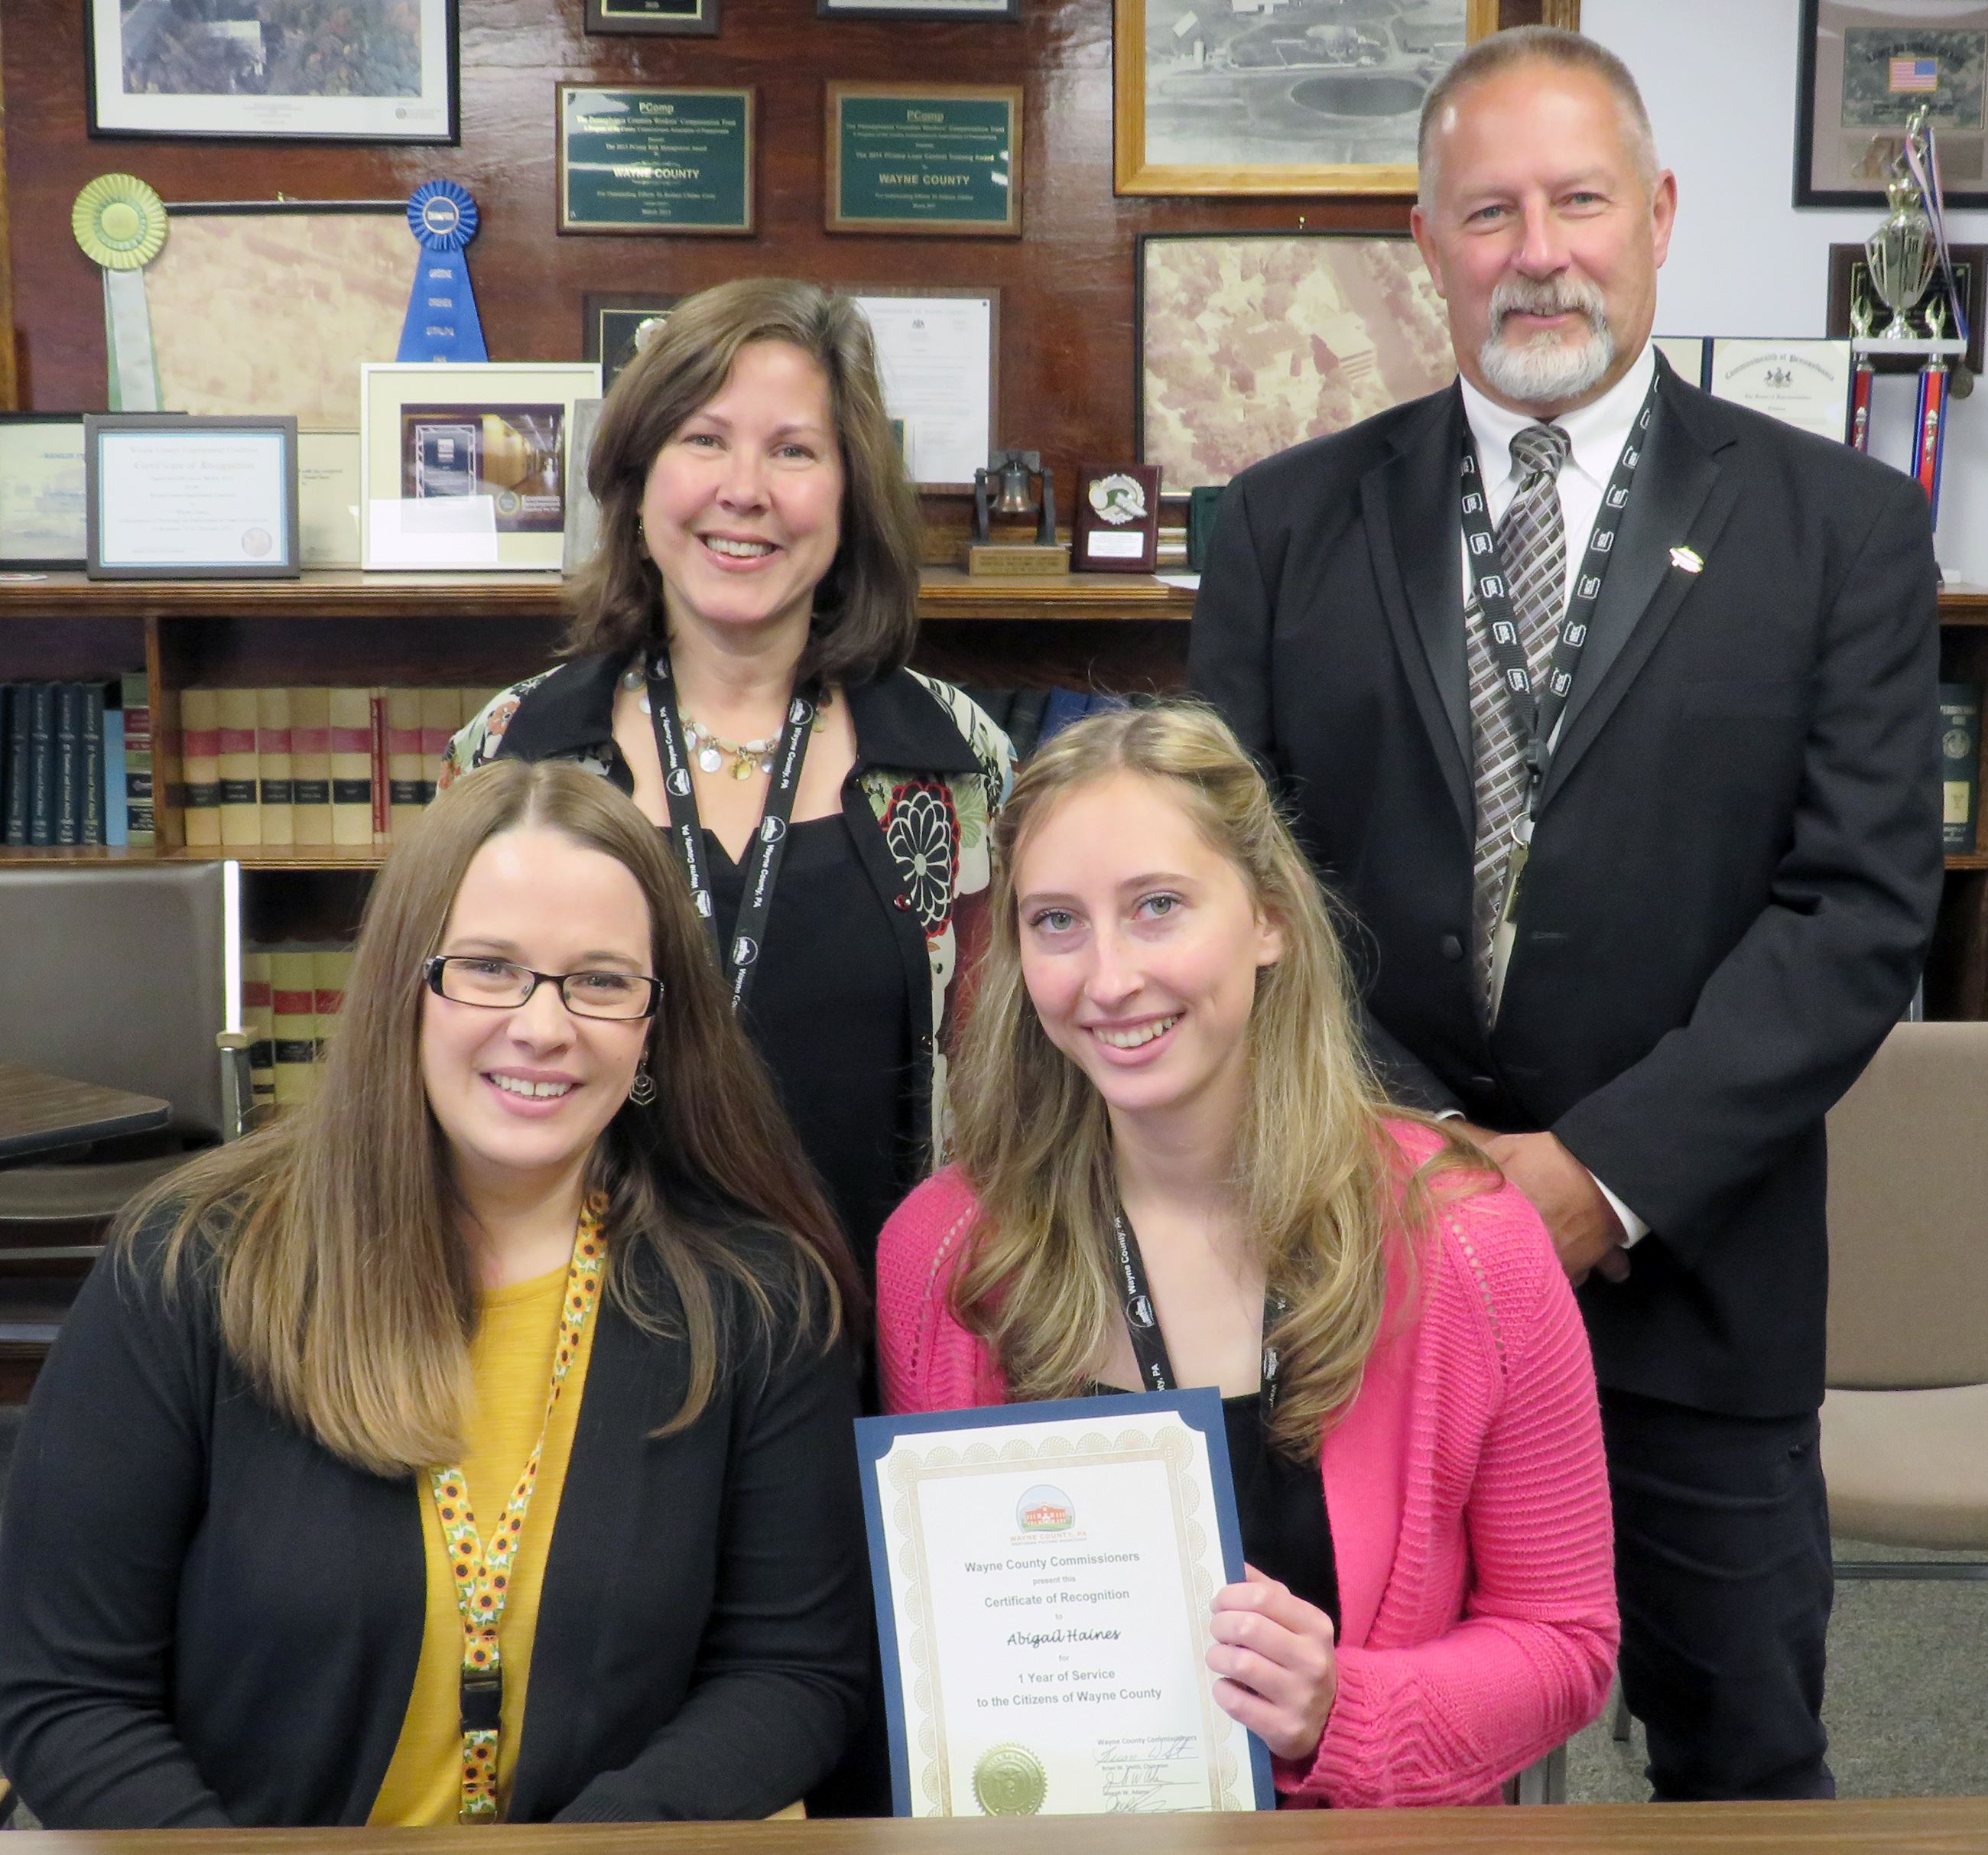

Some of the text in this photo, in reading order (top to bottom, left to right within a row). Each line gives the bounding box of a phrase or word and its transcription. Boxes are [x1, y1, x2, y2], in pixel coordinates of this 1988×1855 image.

[638, 102, 674, 114] PComp
[906, 109, 945, 122] PComp
[612, 166, 700, 179] WAYNE COUNTY
[879, 174, 970, 185] WAYNE COUNTY
[788, 727, 802, 752] Wayne
[681, 824, 690, 836] PA
[762, 844, 775, 869] Wayne
[690, 864, 699, 889] Wayne
[752, 897, 763, 908] PA
[735, 968, 746, 994] Wayne
[1114, 1217, 1122, 1228] PA
[1124, 1264, 1137, 1295] Wayne
[1151, 1363, 1159, 1377] PA
[964, 1552, 1140, 1574] Wayne County Commissioners
[1032, 1577, 1061, 1586] present
[984, 1589, 1130, 1608] Certificate of Recognition
[1007, 1628, 1121, 1649] Abigail Haines
[1018, 1668, 1116, 1684] 1 Year of Service
[977, 1687, 1162, 1707] to the Citizens of Wayne County
[1097, 1738, 1120, 1746] Wayne
[1122, 1736, 1145, 1745] County
